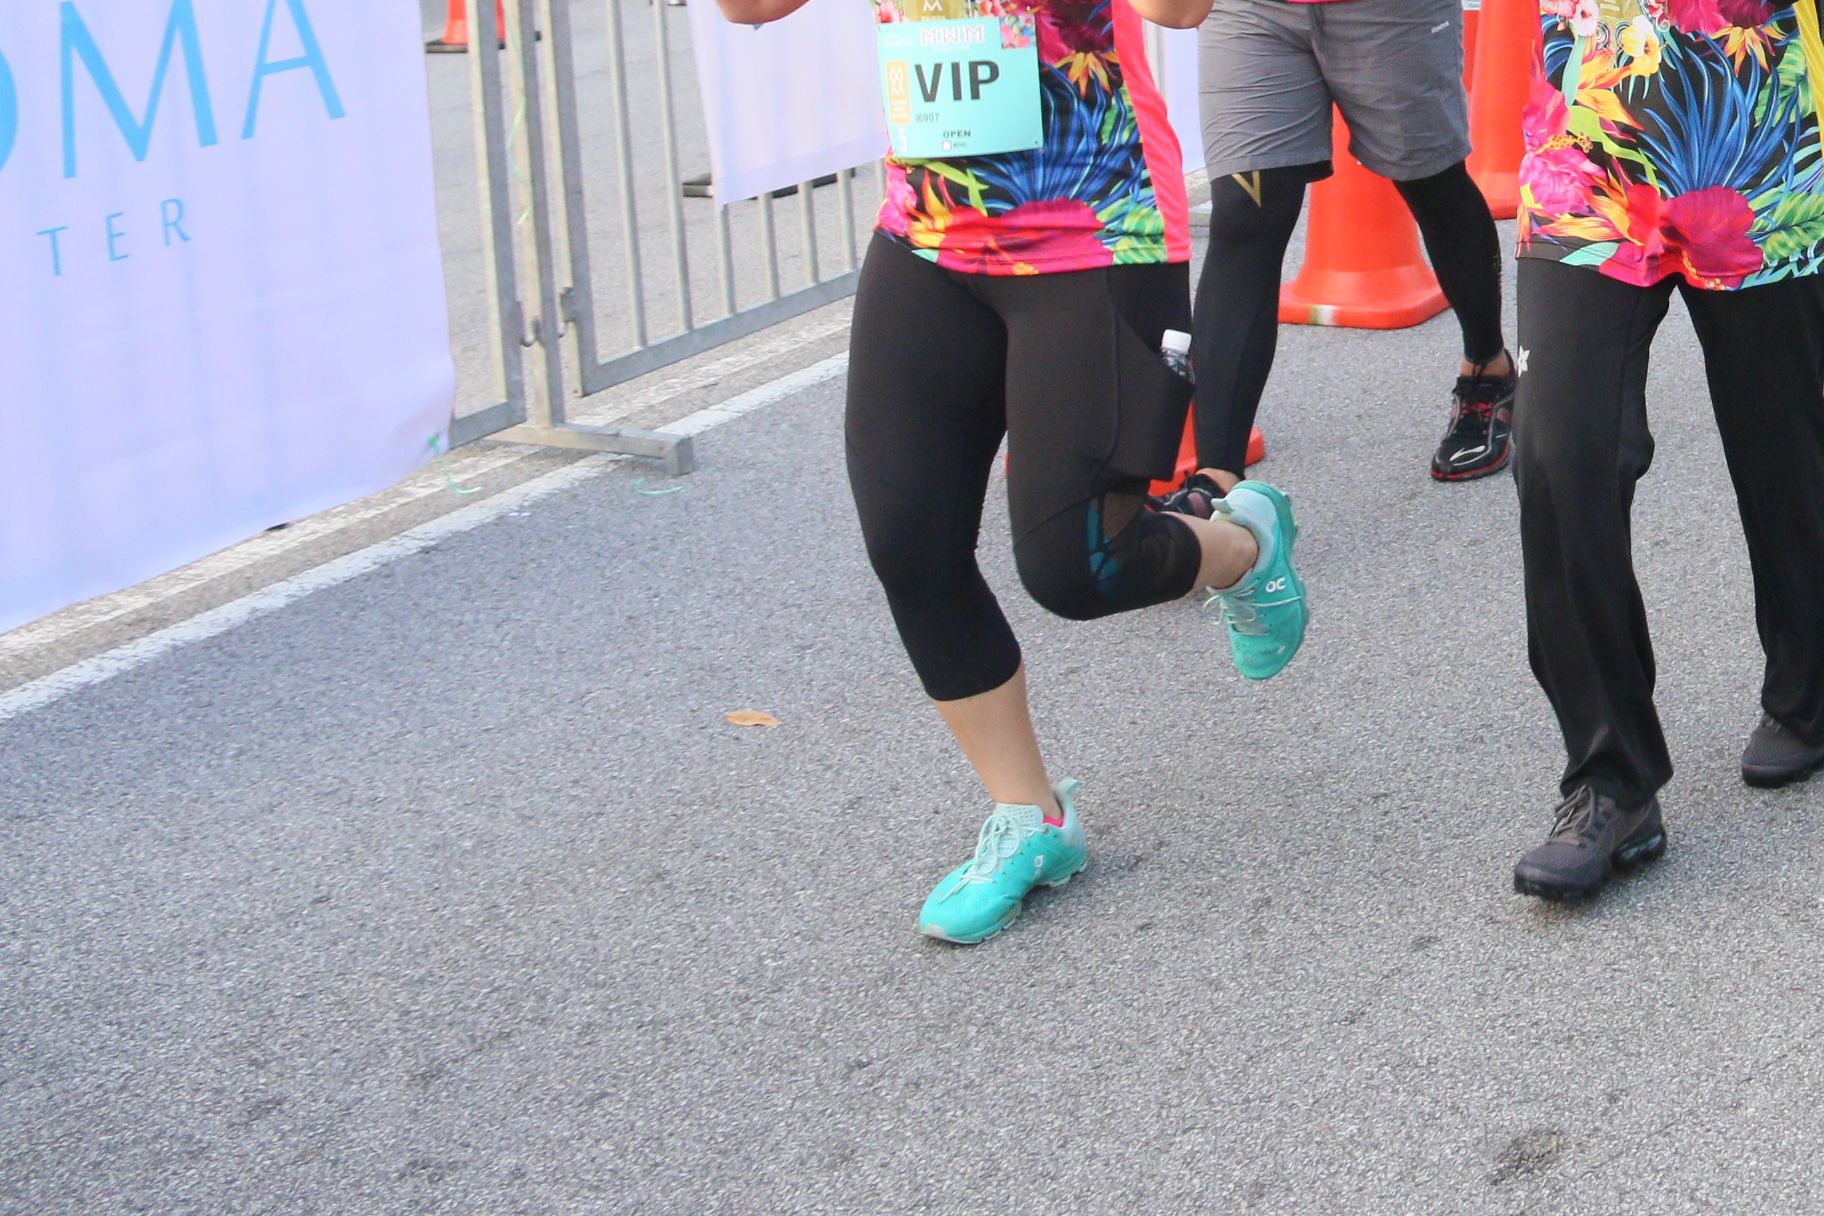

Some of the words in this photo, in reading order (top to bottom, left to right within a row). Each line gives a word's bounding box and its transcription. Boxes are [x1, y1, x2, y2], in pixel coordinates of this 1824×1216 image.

[919, 25, 986, 47] MWM
[914, 60, 1001, 103] VIP
[942, 130, 972, 138] OPEN
